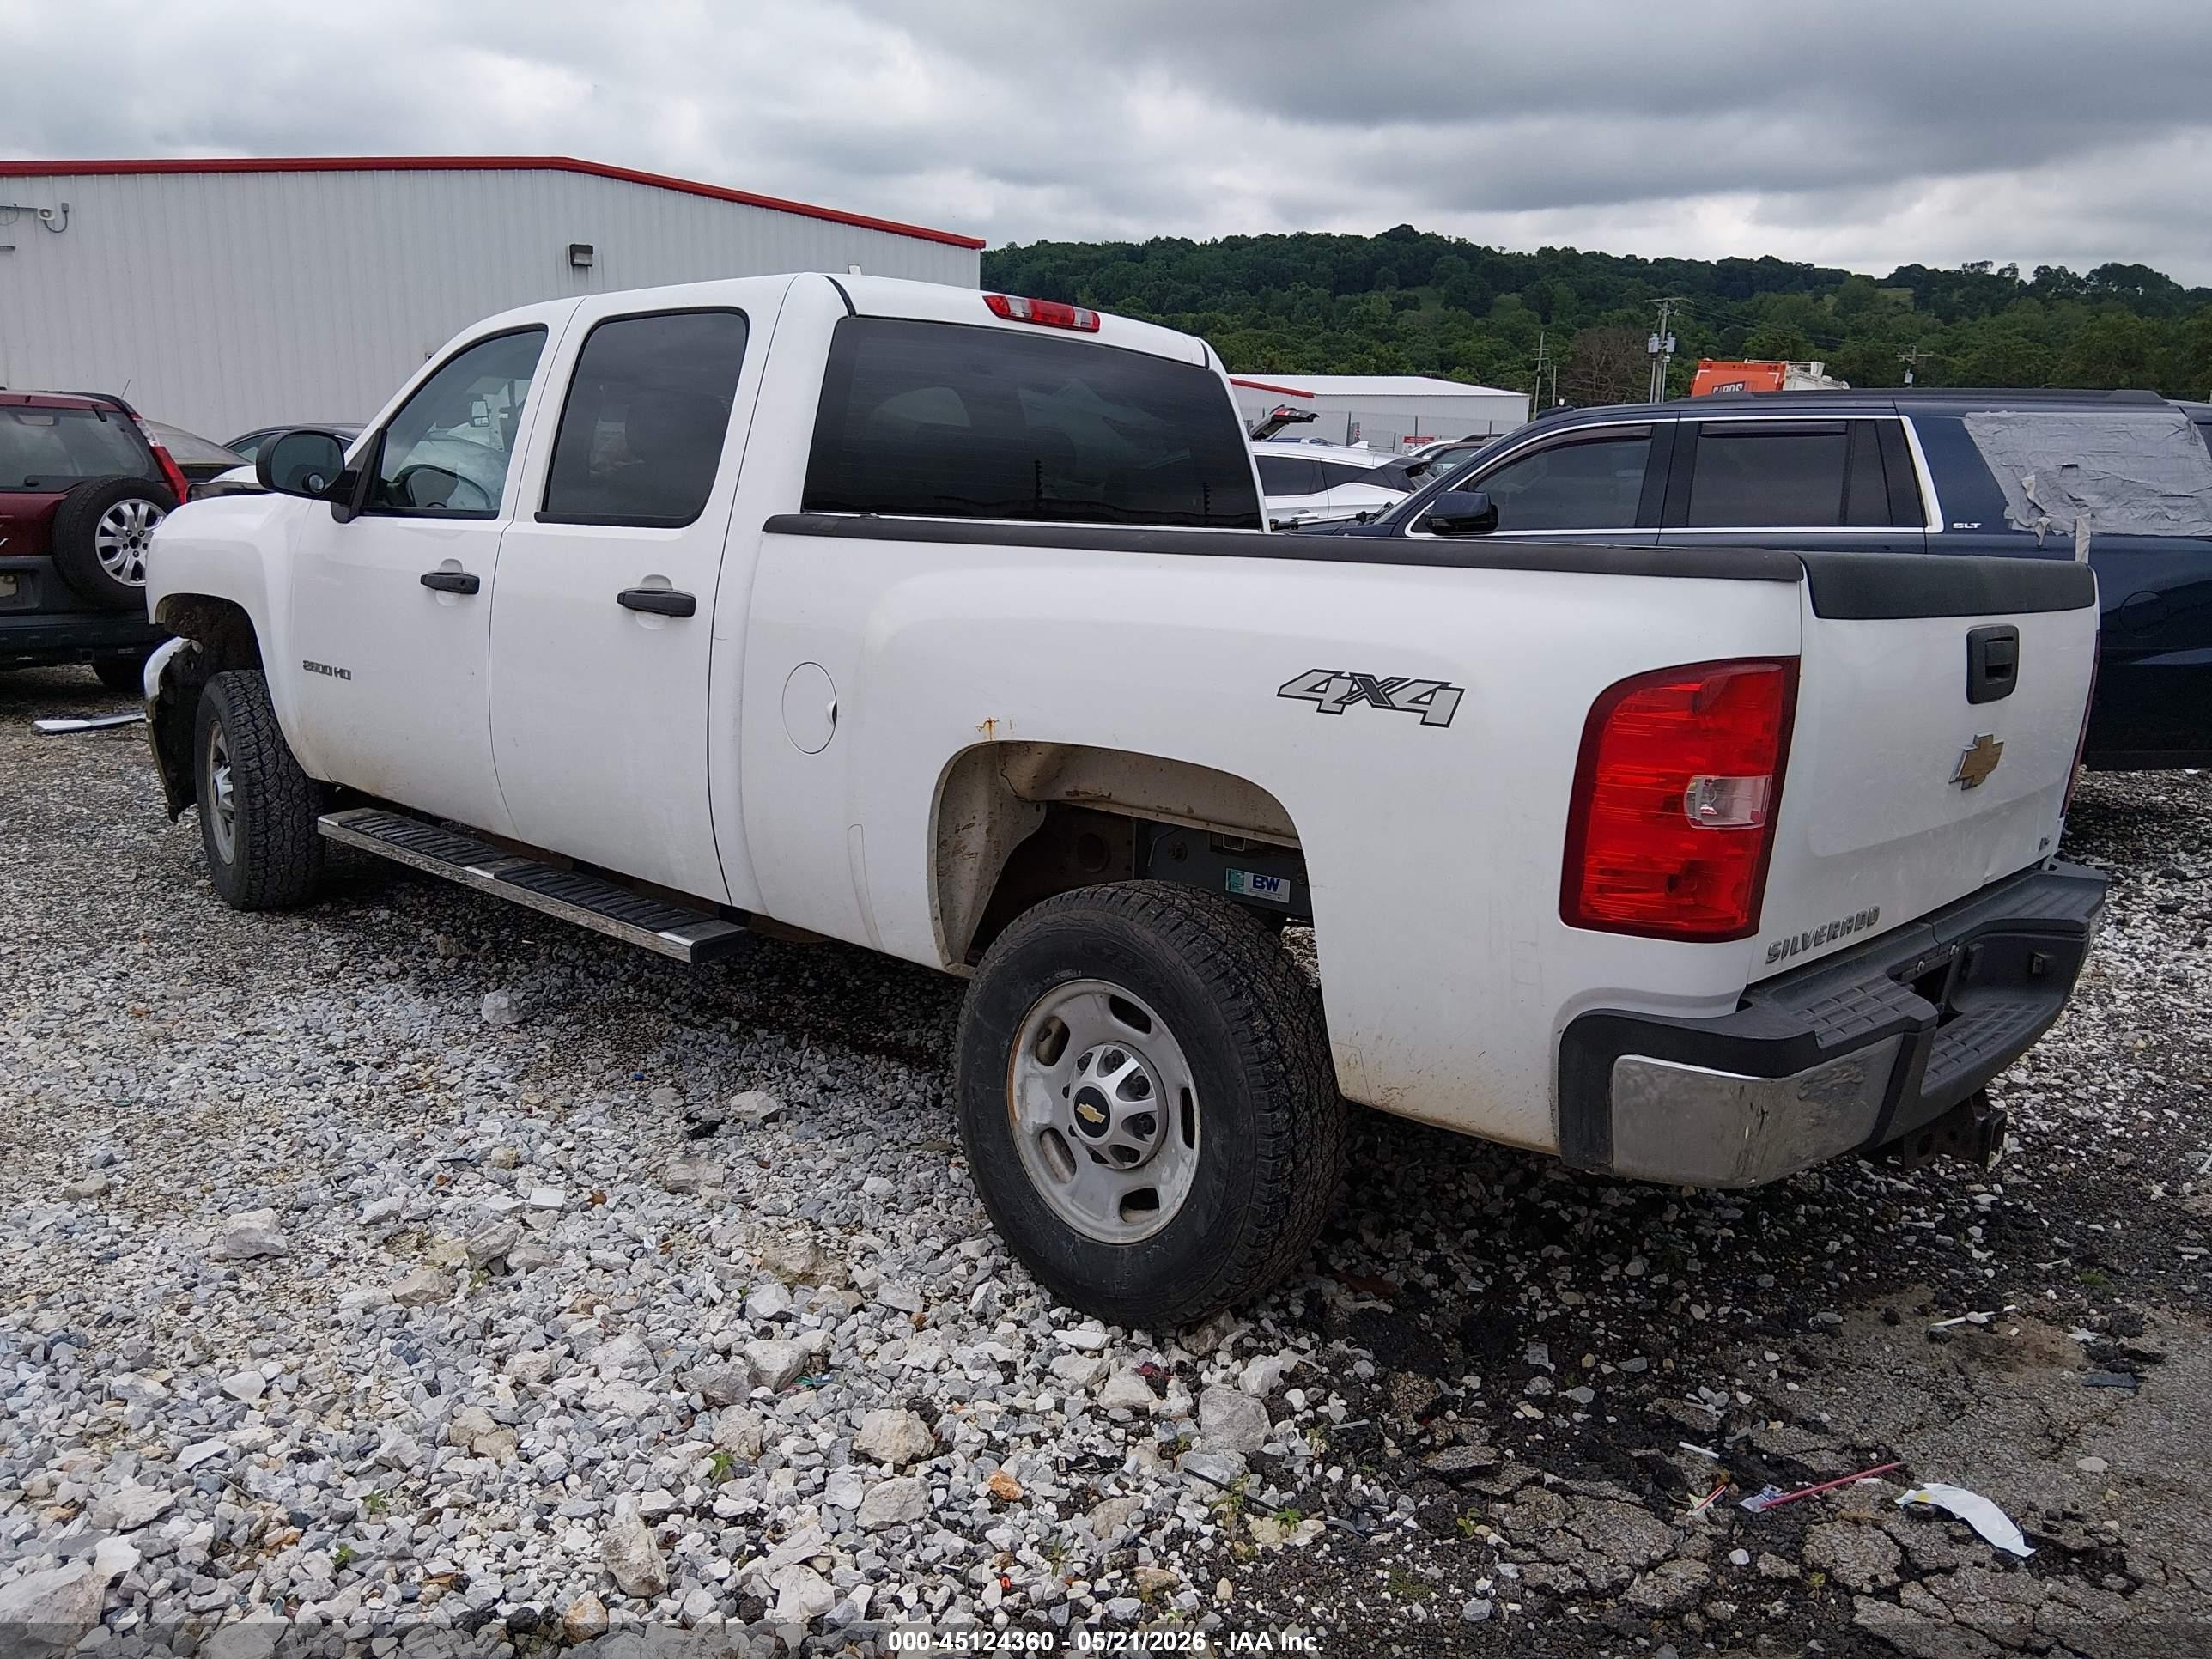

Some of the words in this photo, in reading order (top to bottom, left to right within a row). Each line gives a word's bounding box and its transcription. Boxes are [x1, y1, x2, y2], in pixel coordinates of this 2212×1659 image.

[302, 659, 333, 677] 2500
[333, 666, 352, 681] HD
[1765, 905, 1881, 964] SILVERADO
